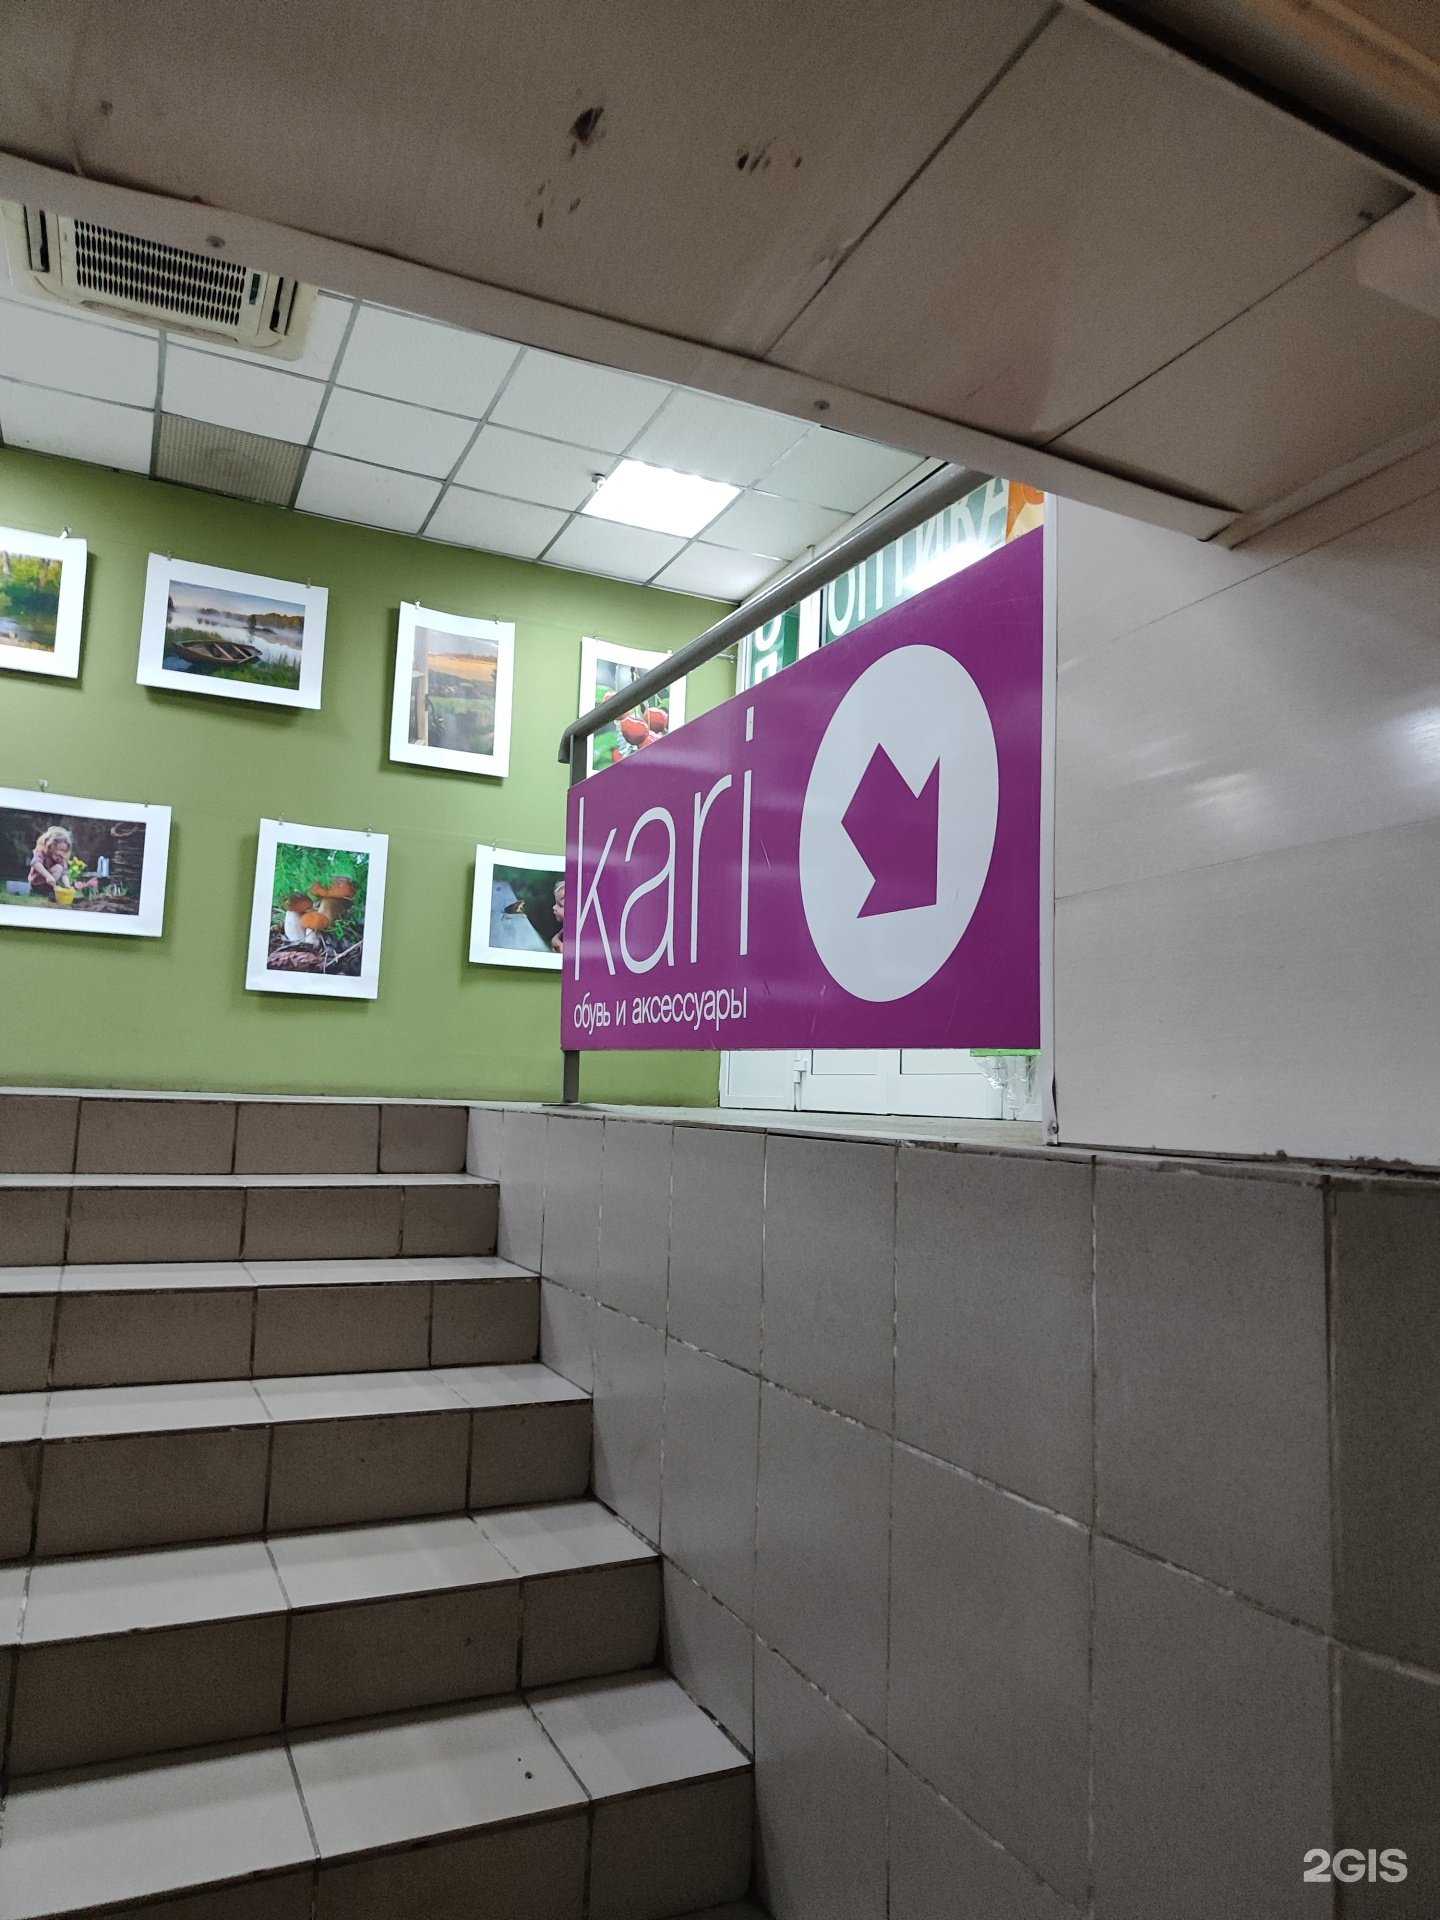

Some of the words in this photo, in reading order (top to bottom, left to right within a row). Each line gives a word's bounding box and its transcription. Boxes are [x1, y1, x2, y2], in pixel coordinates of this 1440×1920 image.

[574, 706, 754, 981] kari
[573, 992, 611, 1035] обувь
[615, 1000, 627, 1026] и
[631, 987, 748, 1031] аксессуары
